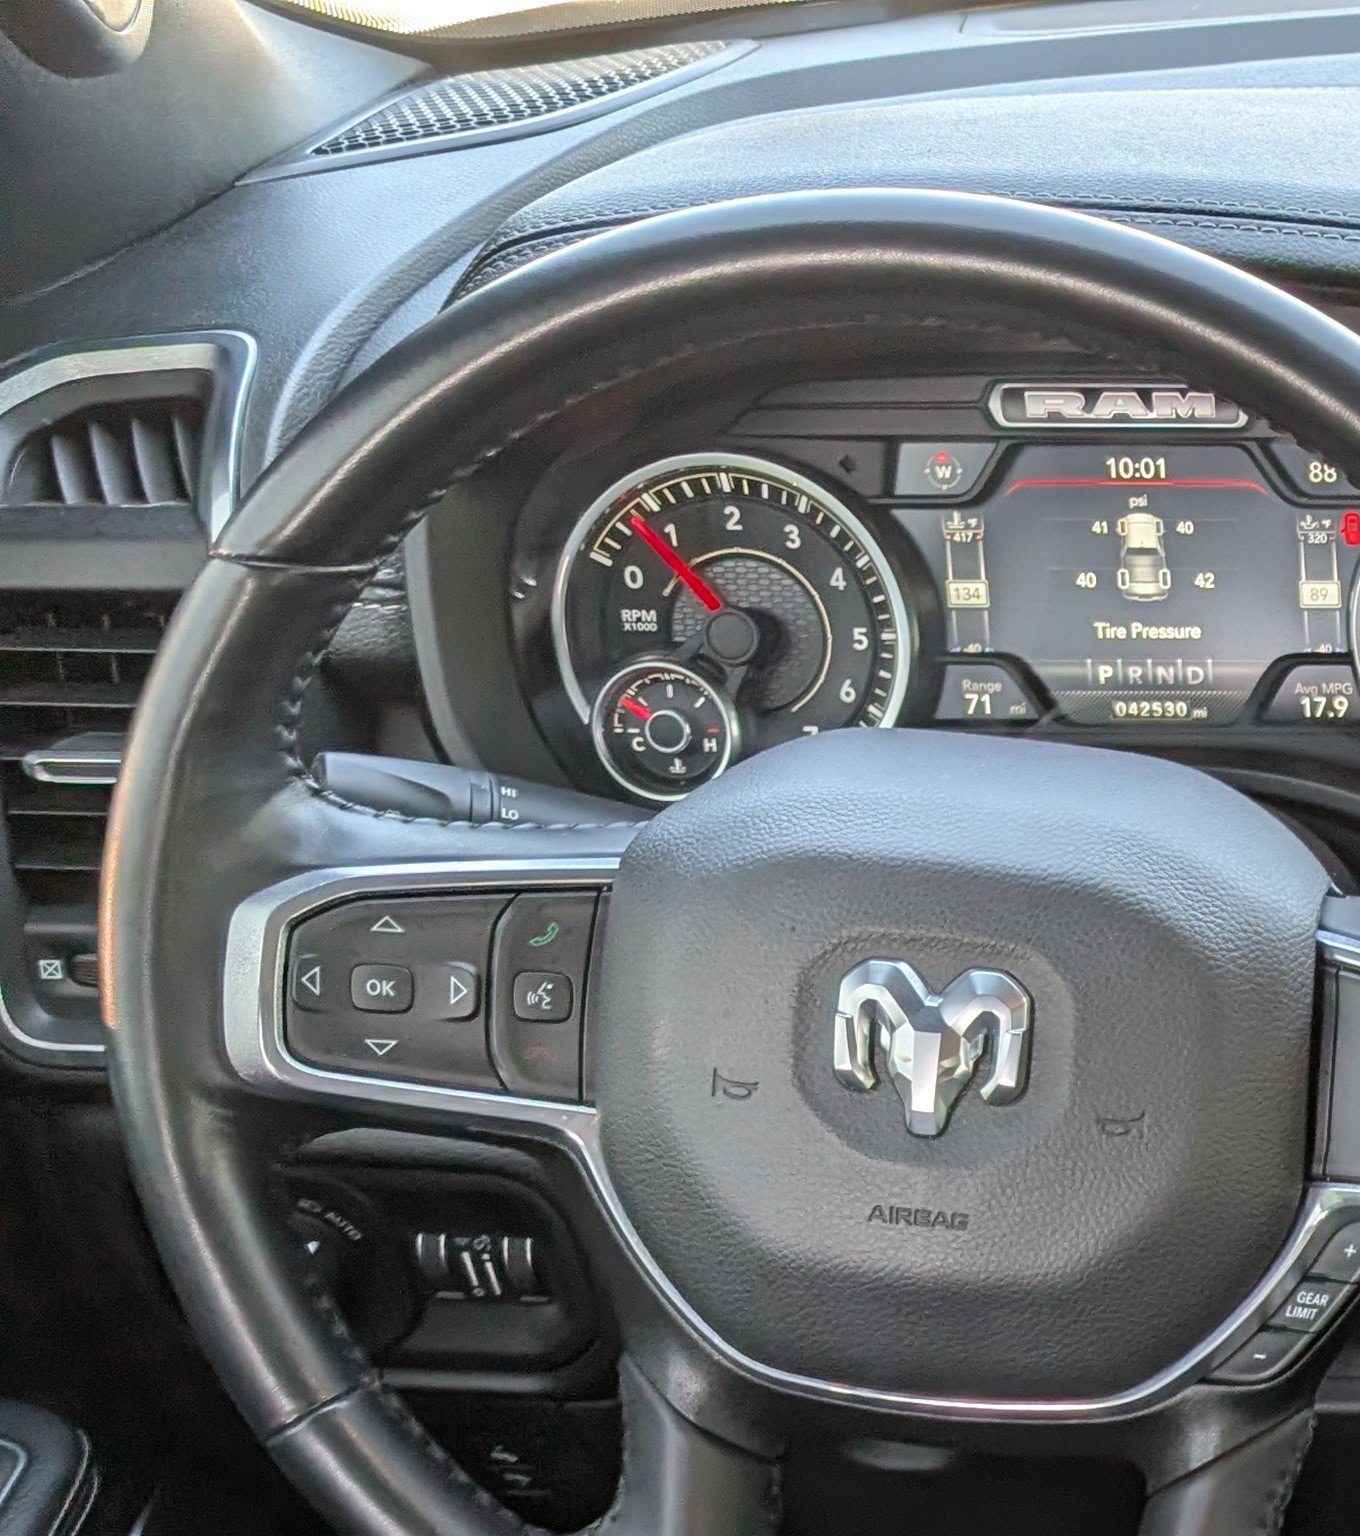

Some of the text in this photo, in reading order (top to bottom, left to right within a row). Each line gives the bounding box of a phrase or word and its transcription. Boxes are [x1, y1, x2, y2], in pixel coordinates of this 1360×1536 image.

[1023, 390, 1216, 420] RAM
[934, 462, 952, 479] W
[1106, 456, 1167, 479] 10:01
[1309, 461, 1338, 483] 88
[1128, 494, 1148, 510] psi
[723, 506, 743, 531] 2
[665, 524, 679, 548] 1
[1091, 520, 1195, 536] 41 40
[784, 525, 803, 549] 3
[953, 532, 974, 543] 417
[1307, 532, 1328, 544] 320
[624, 565, 644, 590] 0
[829, 567, 847, 590] 4
[1076, 573, 1216, 589] 40 42
[952, 587, 981, 602] 134
[1310, 587, 1329, 602] 89
[621, 608, 658, 624] RPM
[622, 623, 658, 633] X1000
[1094, 623, 1202, 640] Tire Pressure
[852, 627, 869, 651] 5
[1099, 666, 1206, 684] P R N D
[839, 680, 857, 703] 6
[961, 679, 1003, 695] Range
[1294, 681, 1353, 698] Avg MPG
[963, 694, 1027, 716] 71 mi
[1115, 701, 1208, 719] 042530 mi
[1300, 697, 1350, 719] 17.9
[631, 738, 646, 752] C
[703, 739, 718, 753] H
[500, 785, 517, 798] HI
[501, 807, 519, 821] LO
[366, 979, 396, 997] OK
[866, 1203, 970, 1231] AIRBAG
[1296, 1291, 1330, 1307] GEAR
[1285, 1305, 1319, 1320] LIMIT
